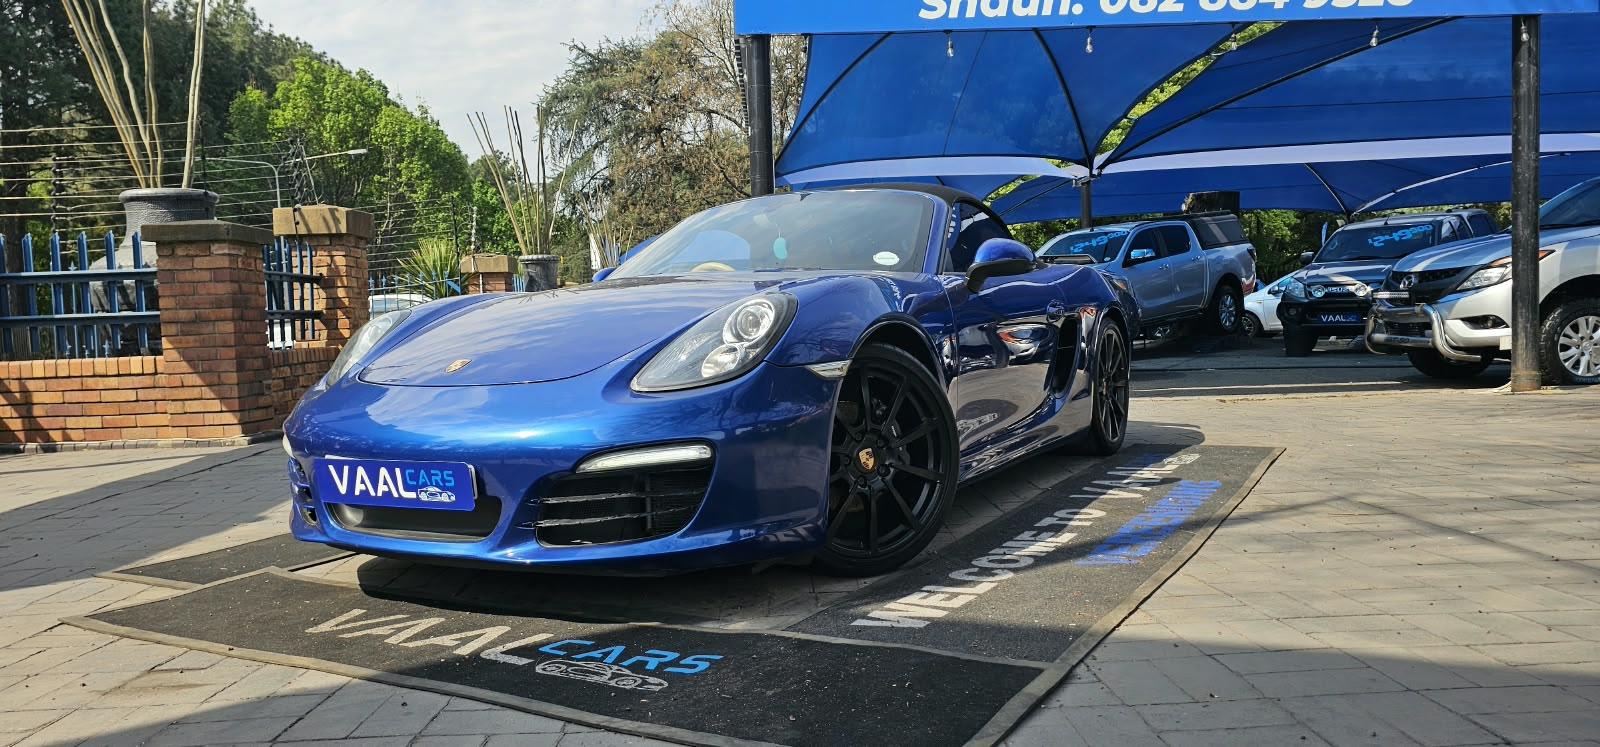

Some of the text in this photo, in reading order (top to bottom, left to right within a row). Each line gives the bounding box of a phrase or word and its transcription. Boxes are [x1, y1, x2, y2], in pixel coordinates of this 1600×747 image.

[1320, 314, 1345, 322] VAAL
[327, 464, 455, 499] VAAL CARS
[850, 529, 1078, 628] WELCOME
[1035, 507, 1106, 527] TO
[305, 608, 724, 675] VAAL CARS
